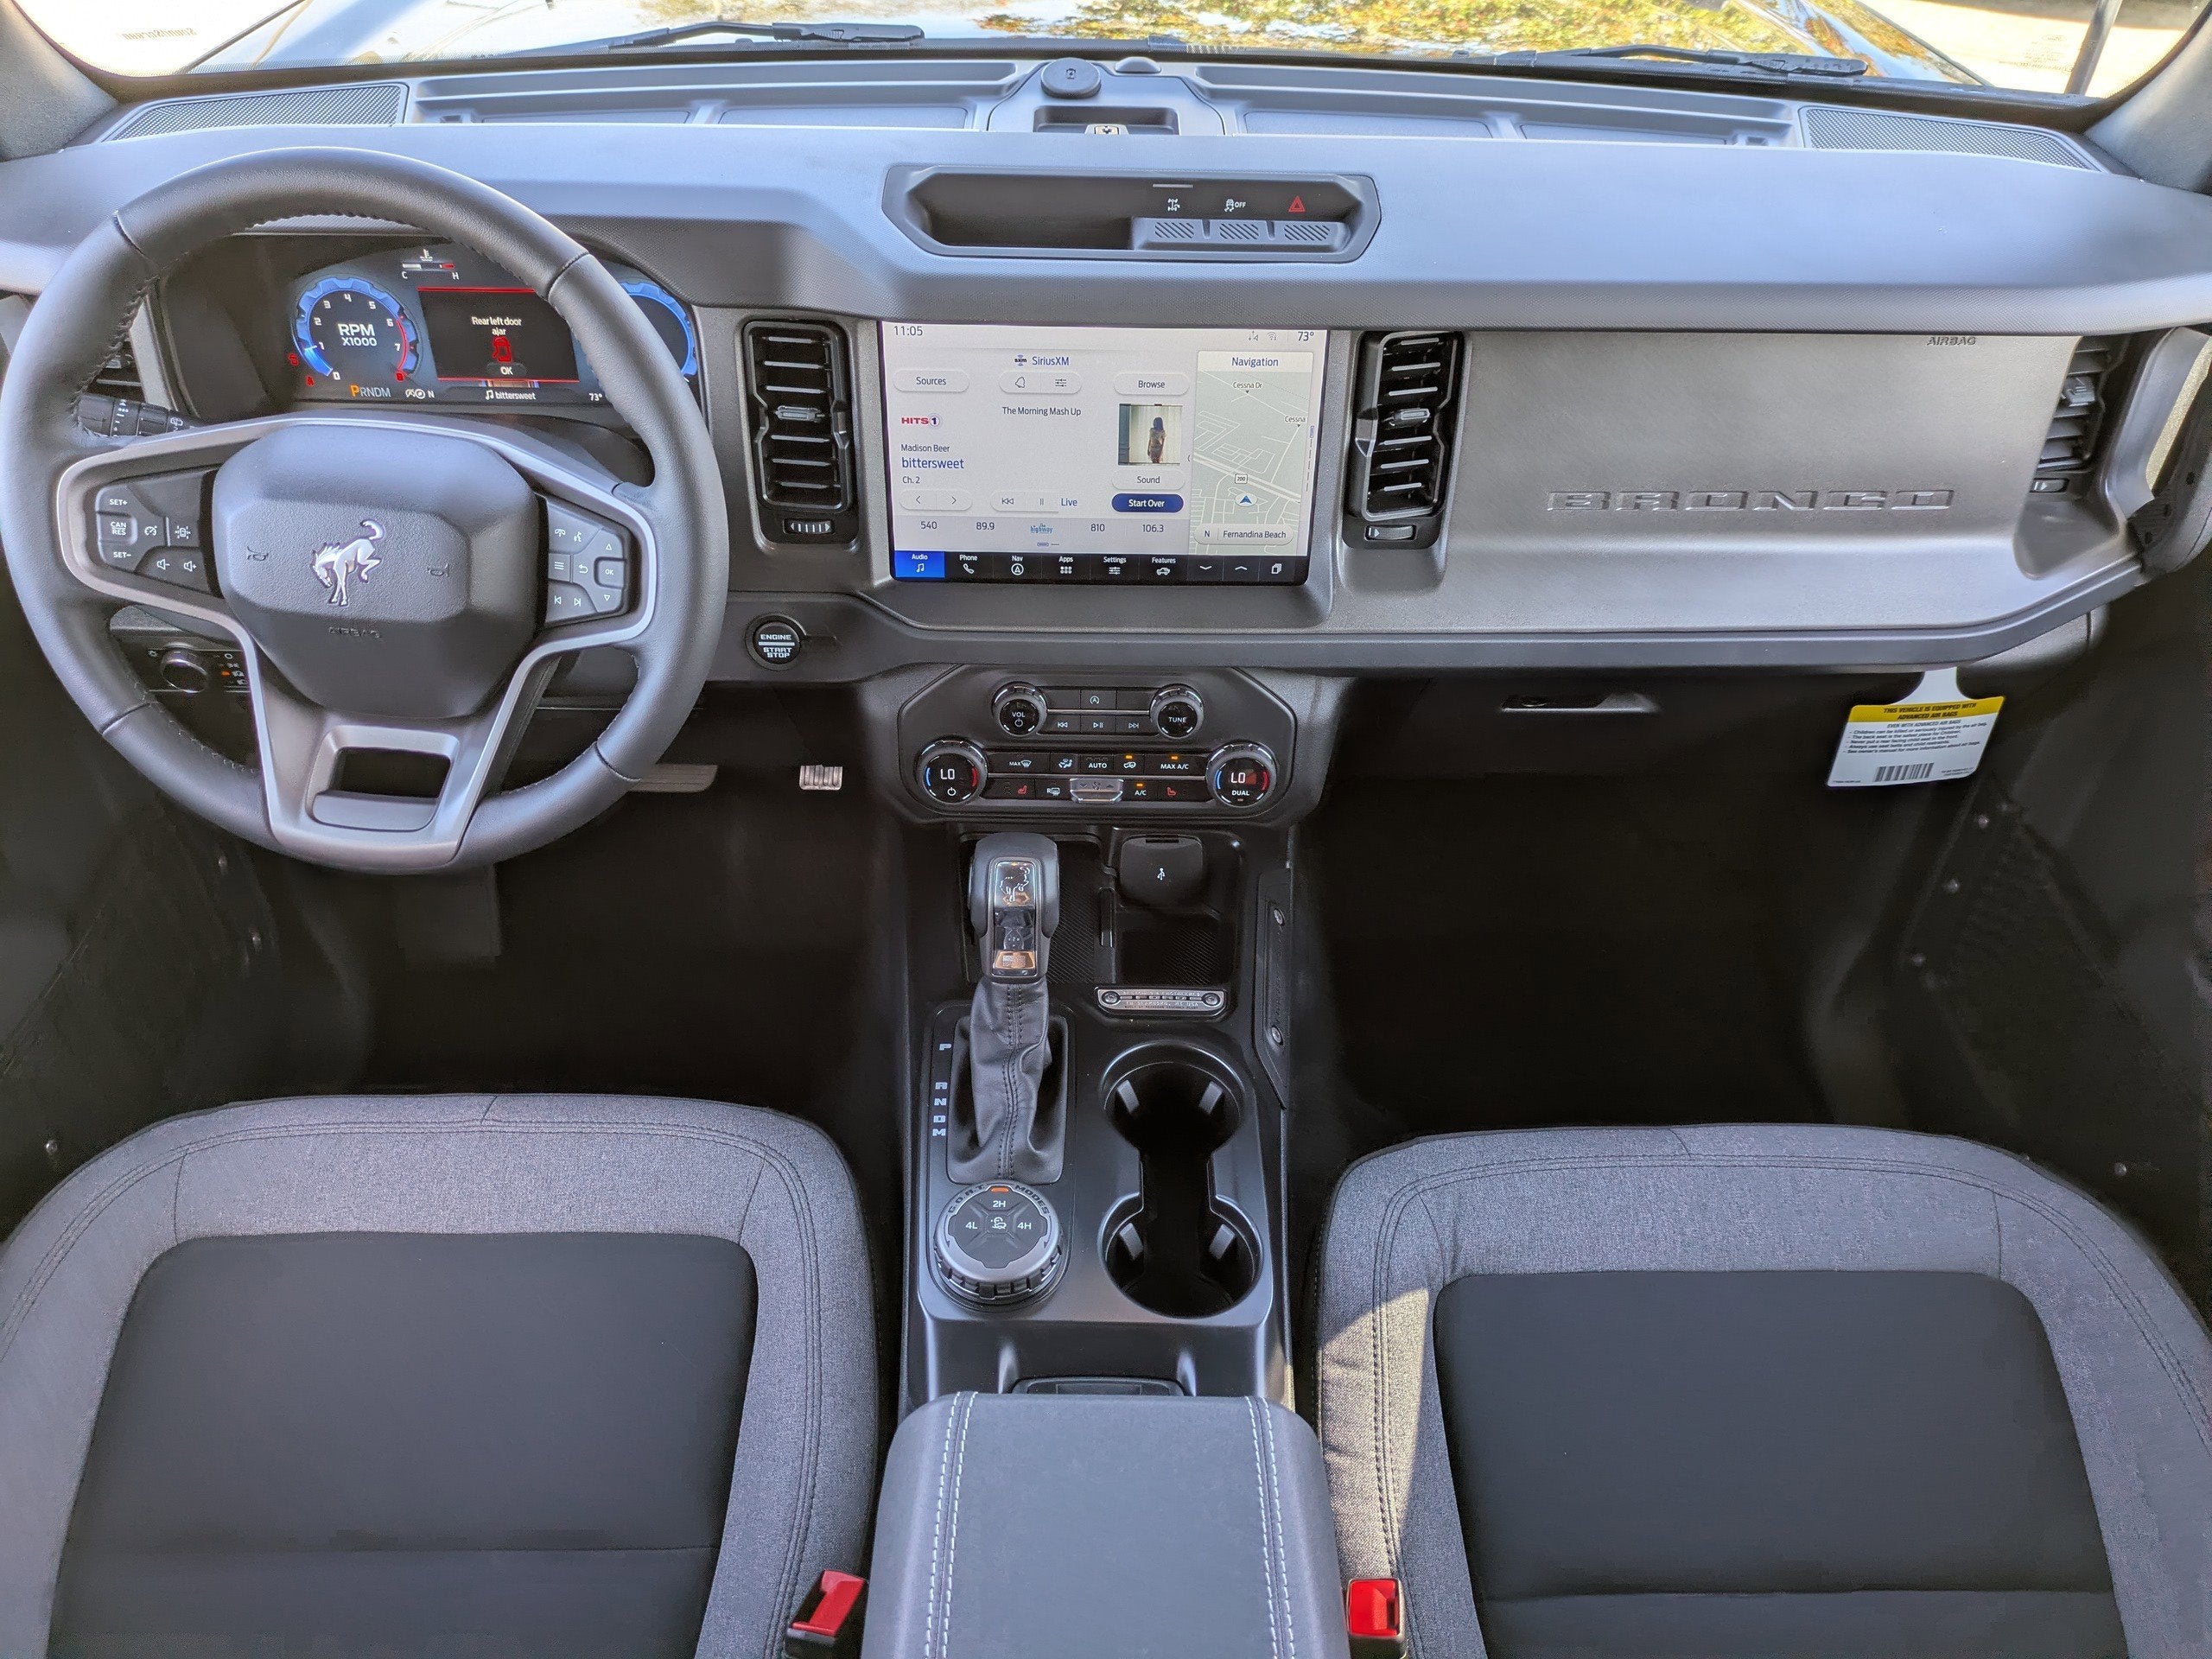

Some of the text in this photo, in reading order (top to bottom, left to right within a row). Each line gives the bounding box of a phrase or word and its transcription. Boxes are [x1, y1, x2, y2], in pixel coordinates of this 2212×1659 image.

[452, 271, 460, 280] H
[344, 293, 352, 302] 4
[323, 300, 331, 309] 3
[368, 301, 377, 310] 5
[314, 316, 321, 326] 2
[386, 318, 394, 327] 6
[471, 316, 522, 327] Rear left door
[337, 323, 376, 336] RPM
[492, 327, 506, 336] ajar
[893, 325, 924, 337] 11:05
[1297, 331, 1315, 342] 73°
[1926, 336, 1977, 346] AIRBAG
[318, 341, 325, 350] 1
[342, 337, 378, 346] X1000
[394, 343, 401, 352] 7
[1032, 355, 1070, 366] SiriusXM
[1231, 357, 1279, 368] Navigation
[332, 371, 340, 380] 0
[499, 366, 513, 376] OK
[916, 377, 947, 386] Sources
[1138, 380, 1166, 389] Browse
[427, 390, 435, 398] N
[495, 391, 536, 400] bittersweet
[589, 392, 603, 401] 73°
[1002, 406, 1082, 417] The Morning Mash Up
[901, 416, 929, 425] HITS
[1284, 415, 1306, 423] Cessna
[900, 443, 950, 453] Madison Beer
[901, 456, 964, 469] bittersweet
[902, 475, 921, 485] Ch. 2
[1136, 475, 1160, 485] Sound
[1060, 498, 1078, 507] Live
[1128, 499, 1166, 508] Start Over
[1547, 489, 1955, 512] BRONCO
[920, 521, 938, 530] 540
[976, 521, 995, 531] 89.9
[1090, 523, 1105, 532] 810
[1142, 524, 1165, 533] 106.3
[1103, 556, 1127, 564] Settings
[940, 768, 956, 780] LO
[1230, 772, 1246, 784] LO
[933, 1115, 946, 1123] D
[1015, 1185, 1050, 1214] MODES
[965, 1221, 978, 1230] 4L
